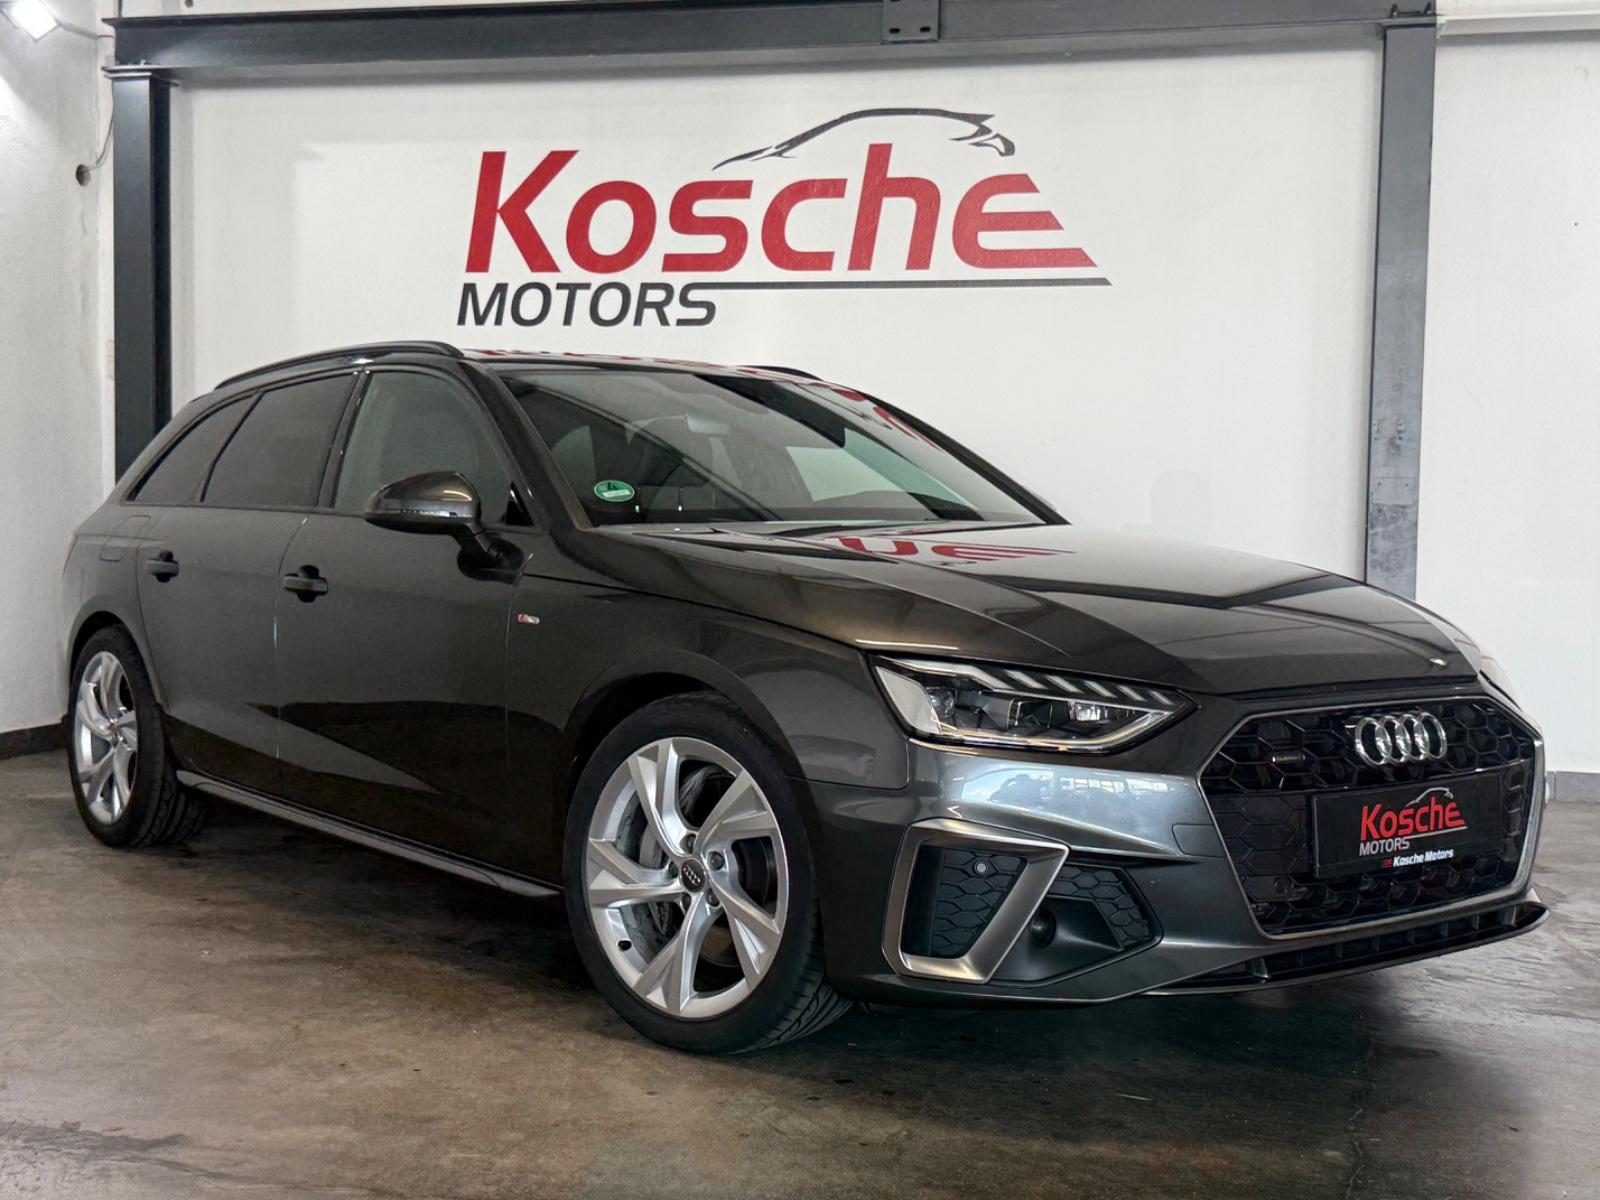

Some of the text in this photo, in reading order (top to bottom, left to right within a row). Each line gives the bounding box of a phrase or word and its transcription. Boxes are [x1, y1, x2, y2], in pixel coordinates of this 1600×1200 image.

[464, 143, 1098, 274] Kosche
[456, 281, 717, 327] MOTORS
[1360, 797, 1465, 841] Kosche
[1359, 837, 1410, 857] MOTORS
[1393, 848, 1455, 868] Kosche Motors
